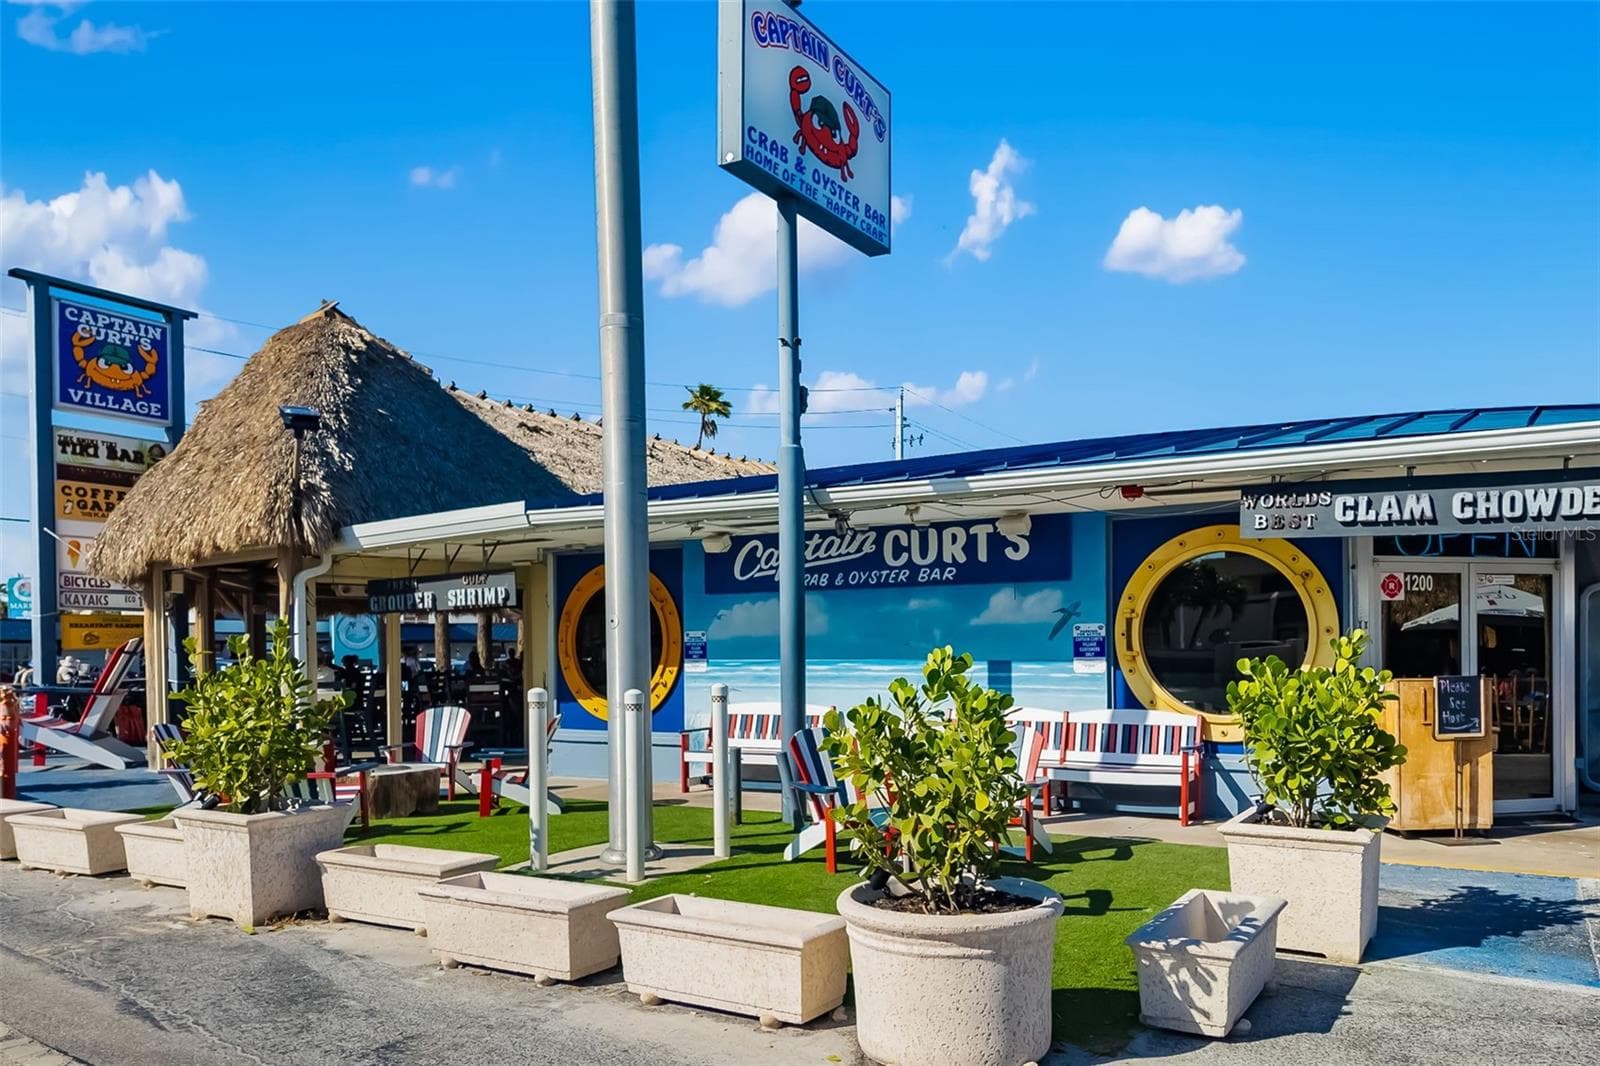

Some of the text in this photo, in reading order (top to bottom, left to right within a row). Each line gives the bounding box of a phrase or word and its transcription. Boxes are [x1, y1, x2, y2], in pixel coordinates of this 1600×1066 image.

[752, 11, 886, 143] CAPTAIN CURT'S
[746, 144, 780, 176] HOME
[782, 168, 797, 184] OF
[799, 178, 818, 201] THE
[747, 126, 886, 229] CRAB & OYSTER BAR
[65, 307, 161, 340] CAPTAIN
[77, 324, 151, 351] CURT'S
[68, 388, 161, 416] VILLAGE
[58, 440, 145, 465] TIKI BAR
[1334, 492, 1438, 526] CLAM
[1452, 486, 1600, 524] CHOWDE
[1254, 514, 1318, 530] BEST
[734, 531, 877, 581] Catain
[63, 576, 111, 588] BICYCLES
[462, 574, 488, 586] GULF
[804, 566, 956, 586] RAB & OYSTER BAR
[1405, 574, 1433, 592] 1200
[64, 594, 109, 606] KAYAKS
[370, 586, 507, 612] GROUPER SHRIMP
[1440, 679, 1470, 693] Please
[1449, 697, 1466, 709] See
[1442, 710, 1465, 724] Host
